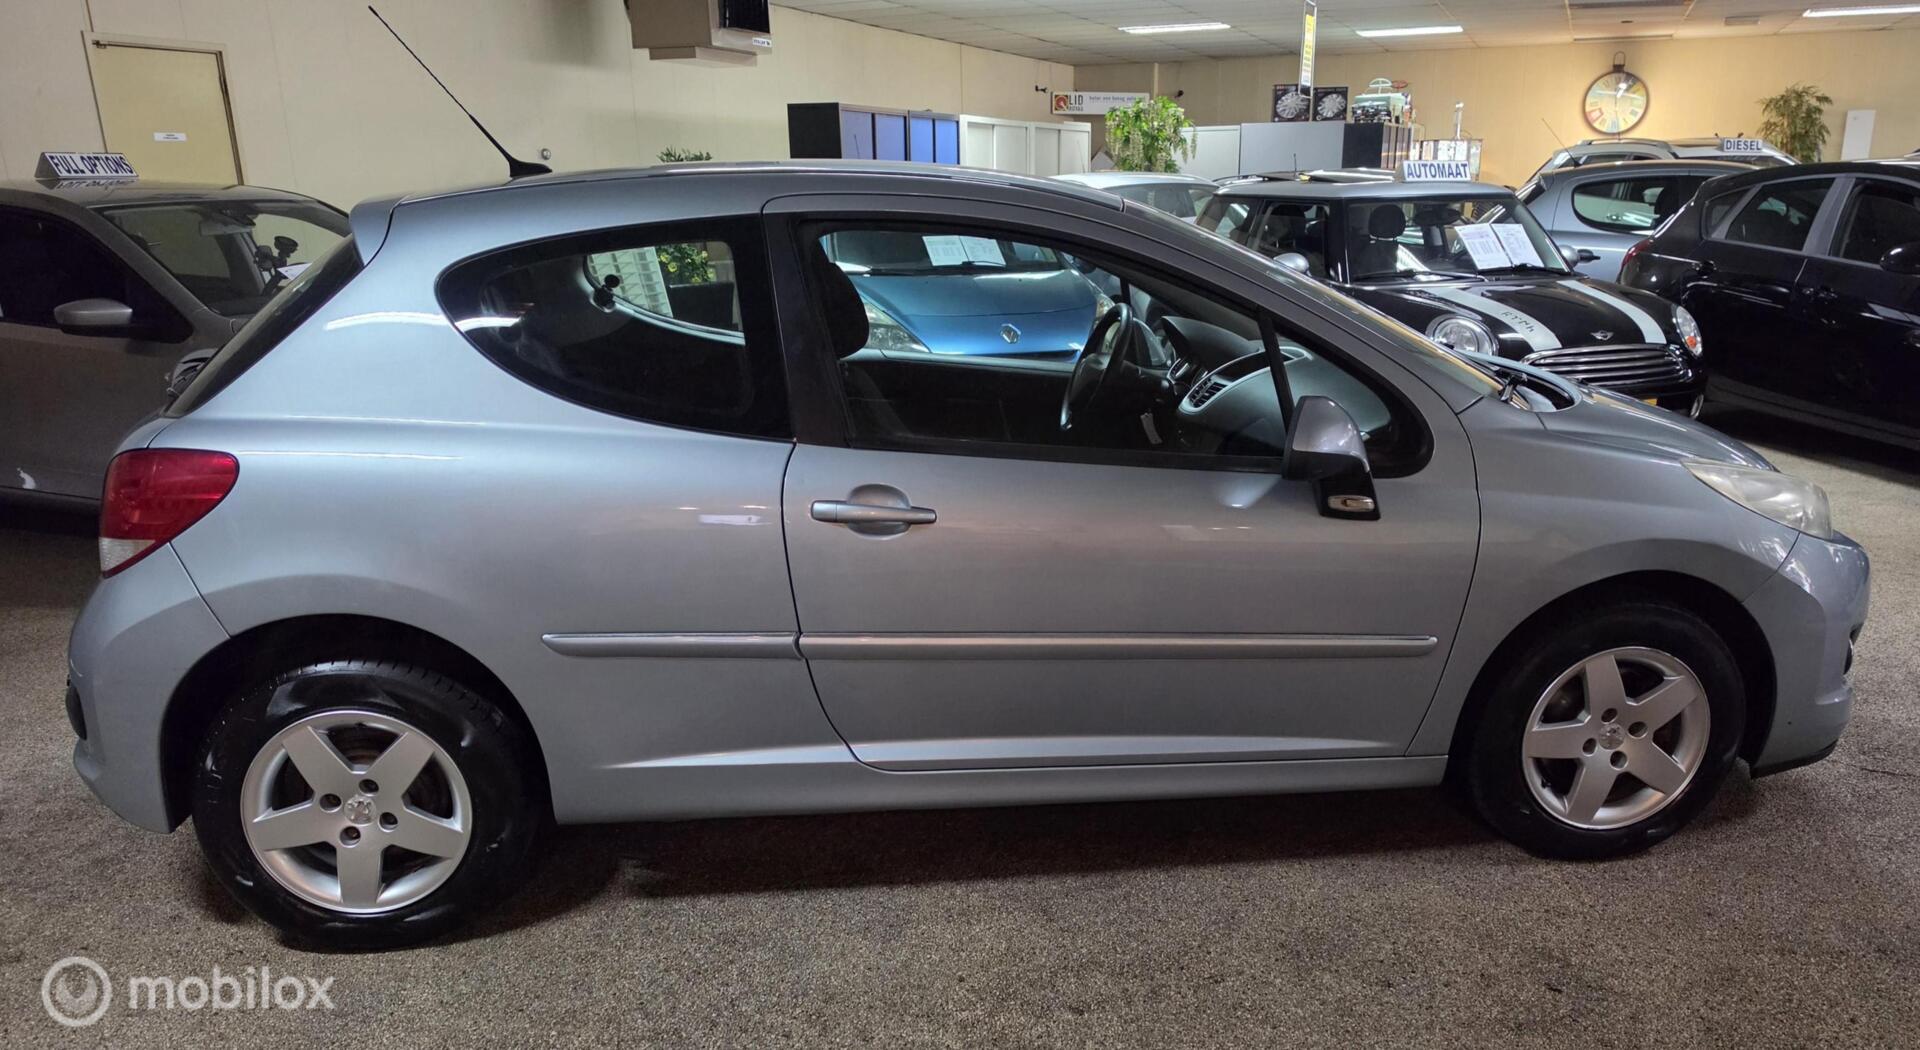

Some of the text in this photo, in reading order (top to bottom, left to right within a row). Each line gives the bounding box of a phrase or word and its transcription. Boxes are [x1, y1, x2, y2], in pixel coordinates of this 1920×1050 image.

[1069, 94, 1084, 105] LID
[1725, 140, 1762, 151] DIESEL
[48, 154, 135, 174] FULL OPTIONS
[1407, 163, 1468, 179] AUTOMAAT
